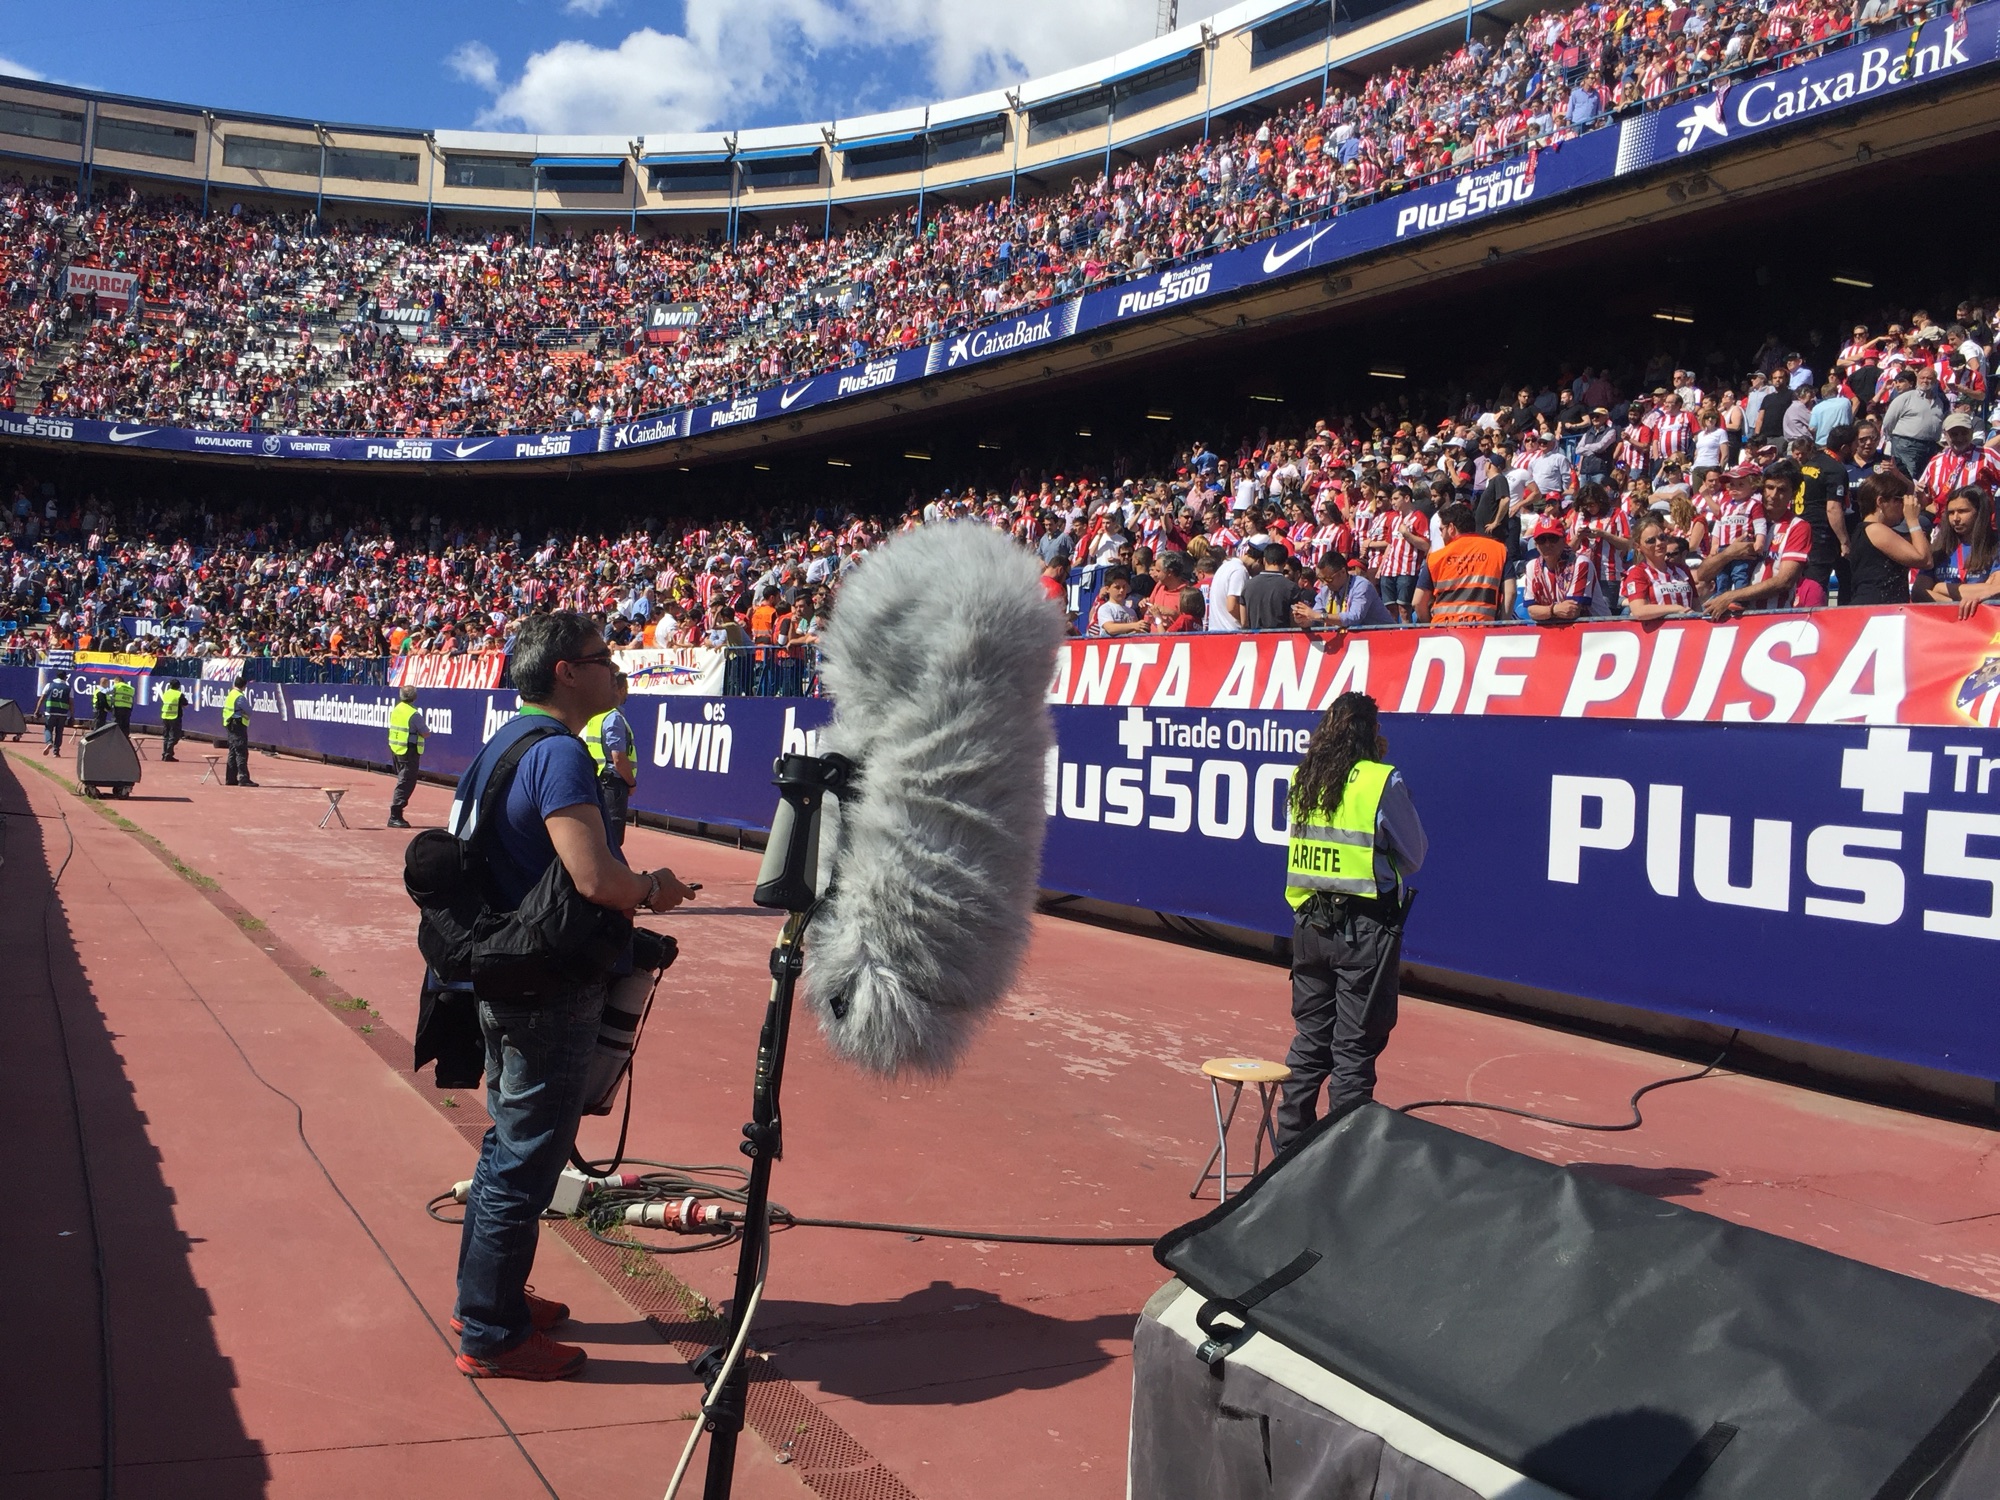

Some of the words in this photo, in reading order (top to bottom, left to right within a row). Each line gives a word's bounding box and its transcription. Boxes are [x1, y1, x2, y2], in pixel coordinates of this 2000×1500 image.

[1737, 24, 1969, 127] CaixaBank
[1475, 171, 1500, 187] Trade
[1505, 160, 1535, 177] Onli
[1396, 175, 1535, 237] Plus500
[70, 272, 132, 293] MARCA
[1172, 267, 1190, 281] Trade
[1191, 262, 1213, 275] Online
[1118, 272, 1210, 316] Plus500
[652, 308, 698, 326] bwin
[971, 313, 1051, 357] CaixaBank
[838, 366, 897, 395] Plus500
[711, 403, 757, 427] Plus500
[195, 436, 252, 448] MOVILNORTE
[629, 417, 677, 444] CaixaBank
[290, 442, 331, 452] VEHINTER
[367, 445, 431, 459] Plus500
[516, 441, 570, 457] Plus500
[1660, 586, 1692, 594] Plus500
[1044, 641, 1191, 707] ANTA
[1210, 639, 1371, 711] ANA
[1560, 616, 1907, 724] PUSA
[52, 688, 63, 699] 91
[653, 702, 733, 773] bwin
[1156, 717, 1220, 749] Trade
[1227, 719, 1311, 754] Online
[1043, 745, 1299, 847] lus500
[1292, 844, 1341, 873] ARIETE
